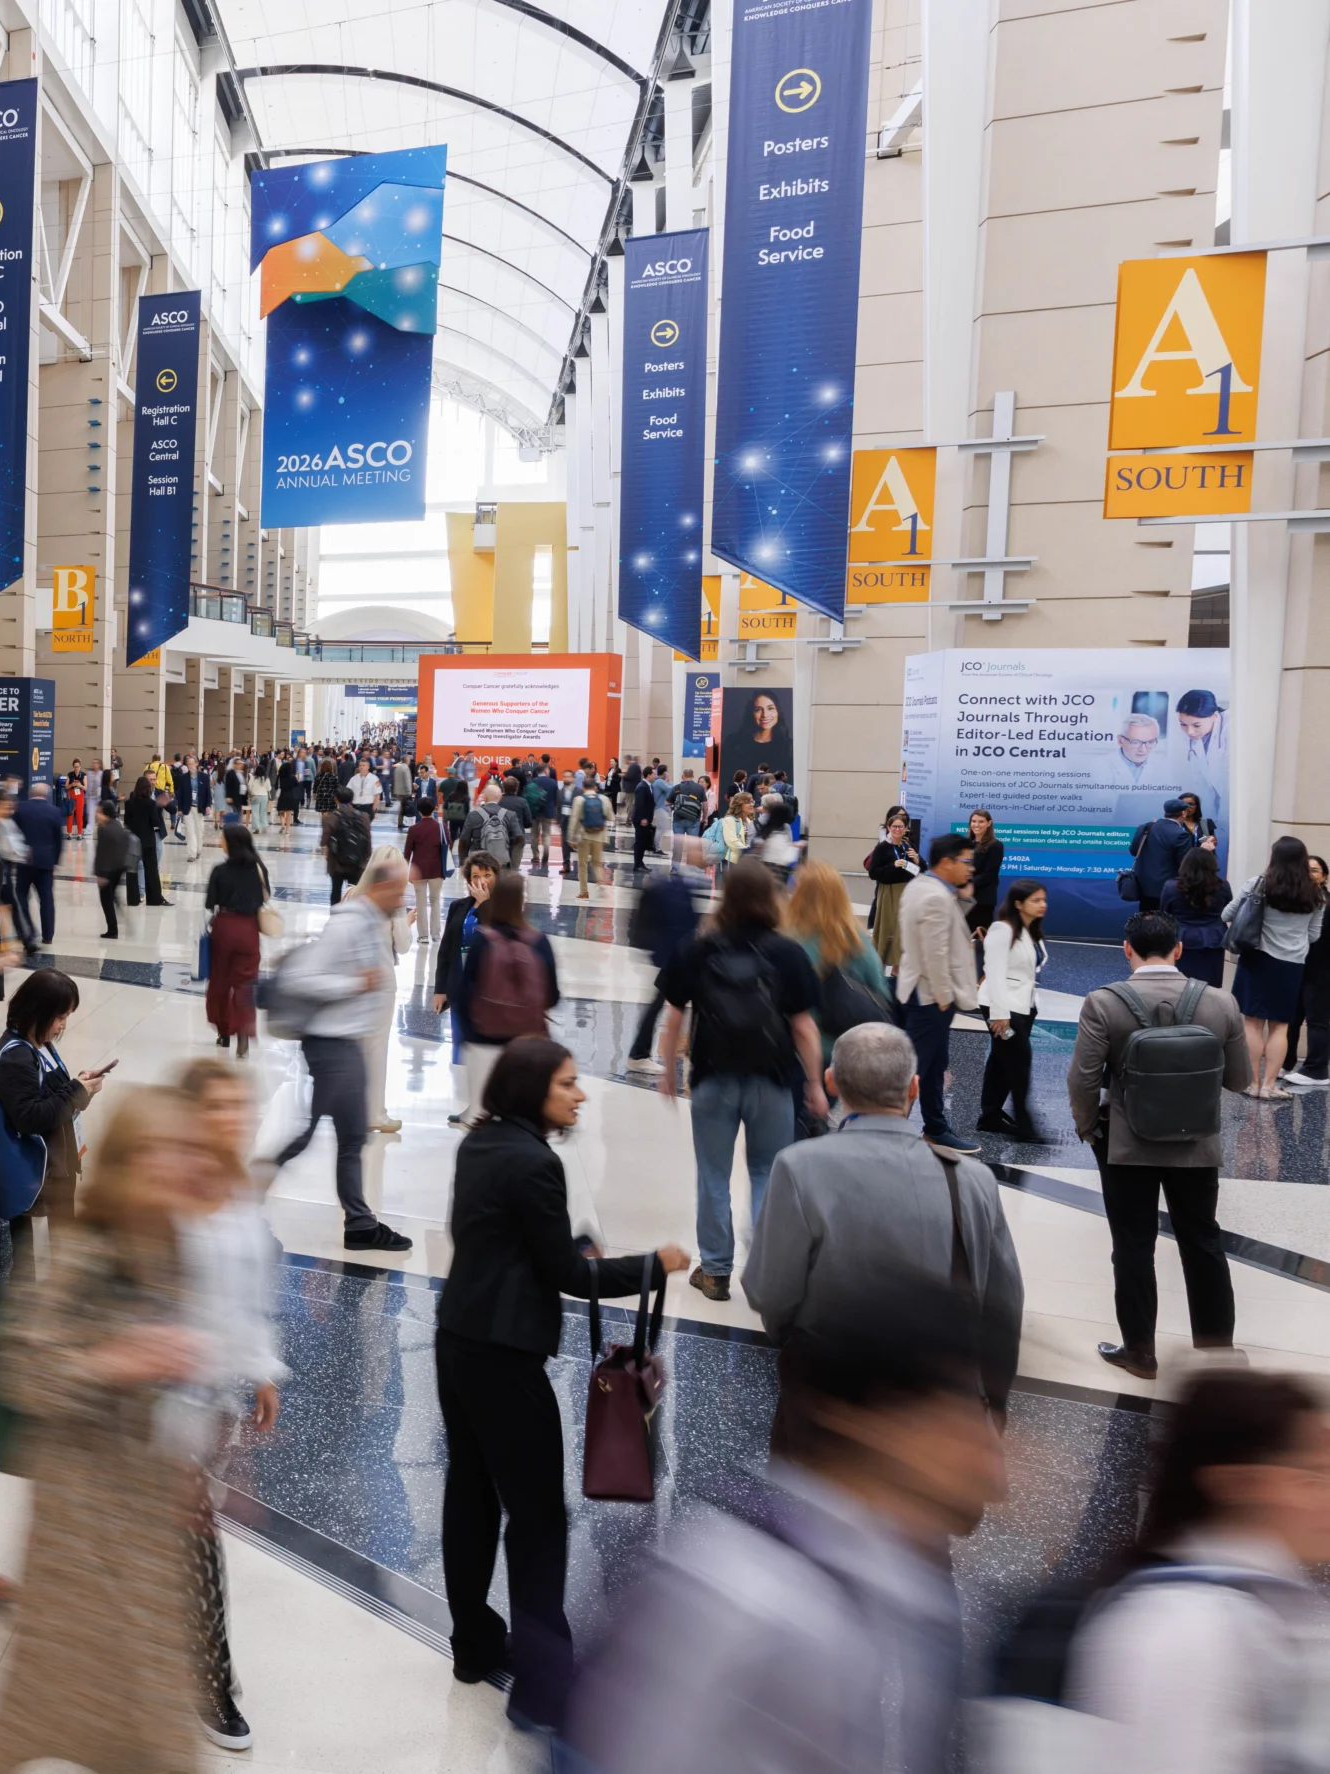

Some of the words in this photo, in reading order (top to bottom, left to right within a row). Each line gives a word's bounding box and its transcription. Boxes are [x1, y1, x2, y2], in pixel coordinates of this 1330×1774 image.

[744, 4, 772, 14] AMERICAN
[744, 9, 788, 21] KNOWLEDGE
[790, 1, 830, 12] CONQUERS
[763, 136, 829, 157] Posters
[759, 178, 829, 200] Exhibits
[770, 221, 814, 242] Food
[758, 246, 824, 265] Service
[642, 258, 692, 278] ASCO
[151, 310, 188, 326] ASCO
[644, 361, 685, 373] Posters
[643, 387, 685, 400] Exhibits
[142, 404, 190, 417] Registration
[153, 416, 169, 426] Hall
[171, 416, 178, 425] C
[650, 414, 677, 426] Food
[643, 428, 683, 440] Service
[151, 440, 178, 450] ASCO
[149, 451, 179, 461] Central
[276, 454, 322, 473] 2026
[323, 440, 412, 470] ASCO
[148, 475, 178, 484] Session
[276, 474, 338, 489] ANNUAL
[342, 469, 410, 486] MEETING
[1116, 464, 1246, 491] SOUTH
[149, 486, 165, 496] Hall
[167, 486, 176, 495] B1
[852, 572, 926, 588] SOUTH
[742, 618, 793, 628] SOUTH
[54, 635, 91, 643] NORTH
[960, 662, 982, 672] JCO
[987, 662, 1026, 672] Journals
[958, 694, 1021, 705] Connect
[1026, 694, 1057, 705] with
[1062, 694, 1095, 706] JCO
[957, 711, 1020, 723] Journals
[1025, 712, 1088, 726] Through
[957, 729, 1034, 740] Editor-Led
[1039, 730, 1114, 741] Education
[956, 746, 968, 756] in
[973, 746, 1005, 757] JCO
[1009, 747, 1066, 758] Central
[1013, 770, 1055, 778] mentoring
[1131, 783, 1182, 792] publications
[960, 792, 1001, 800] Expert-led
